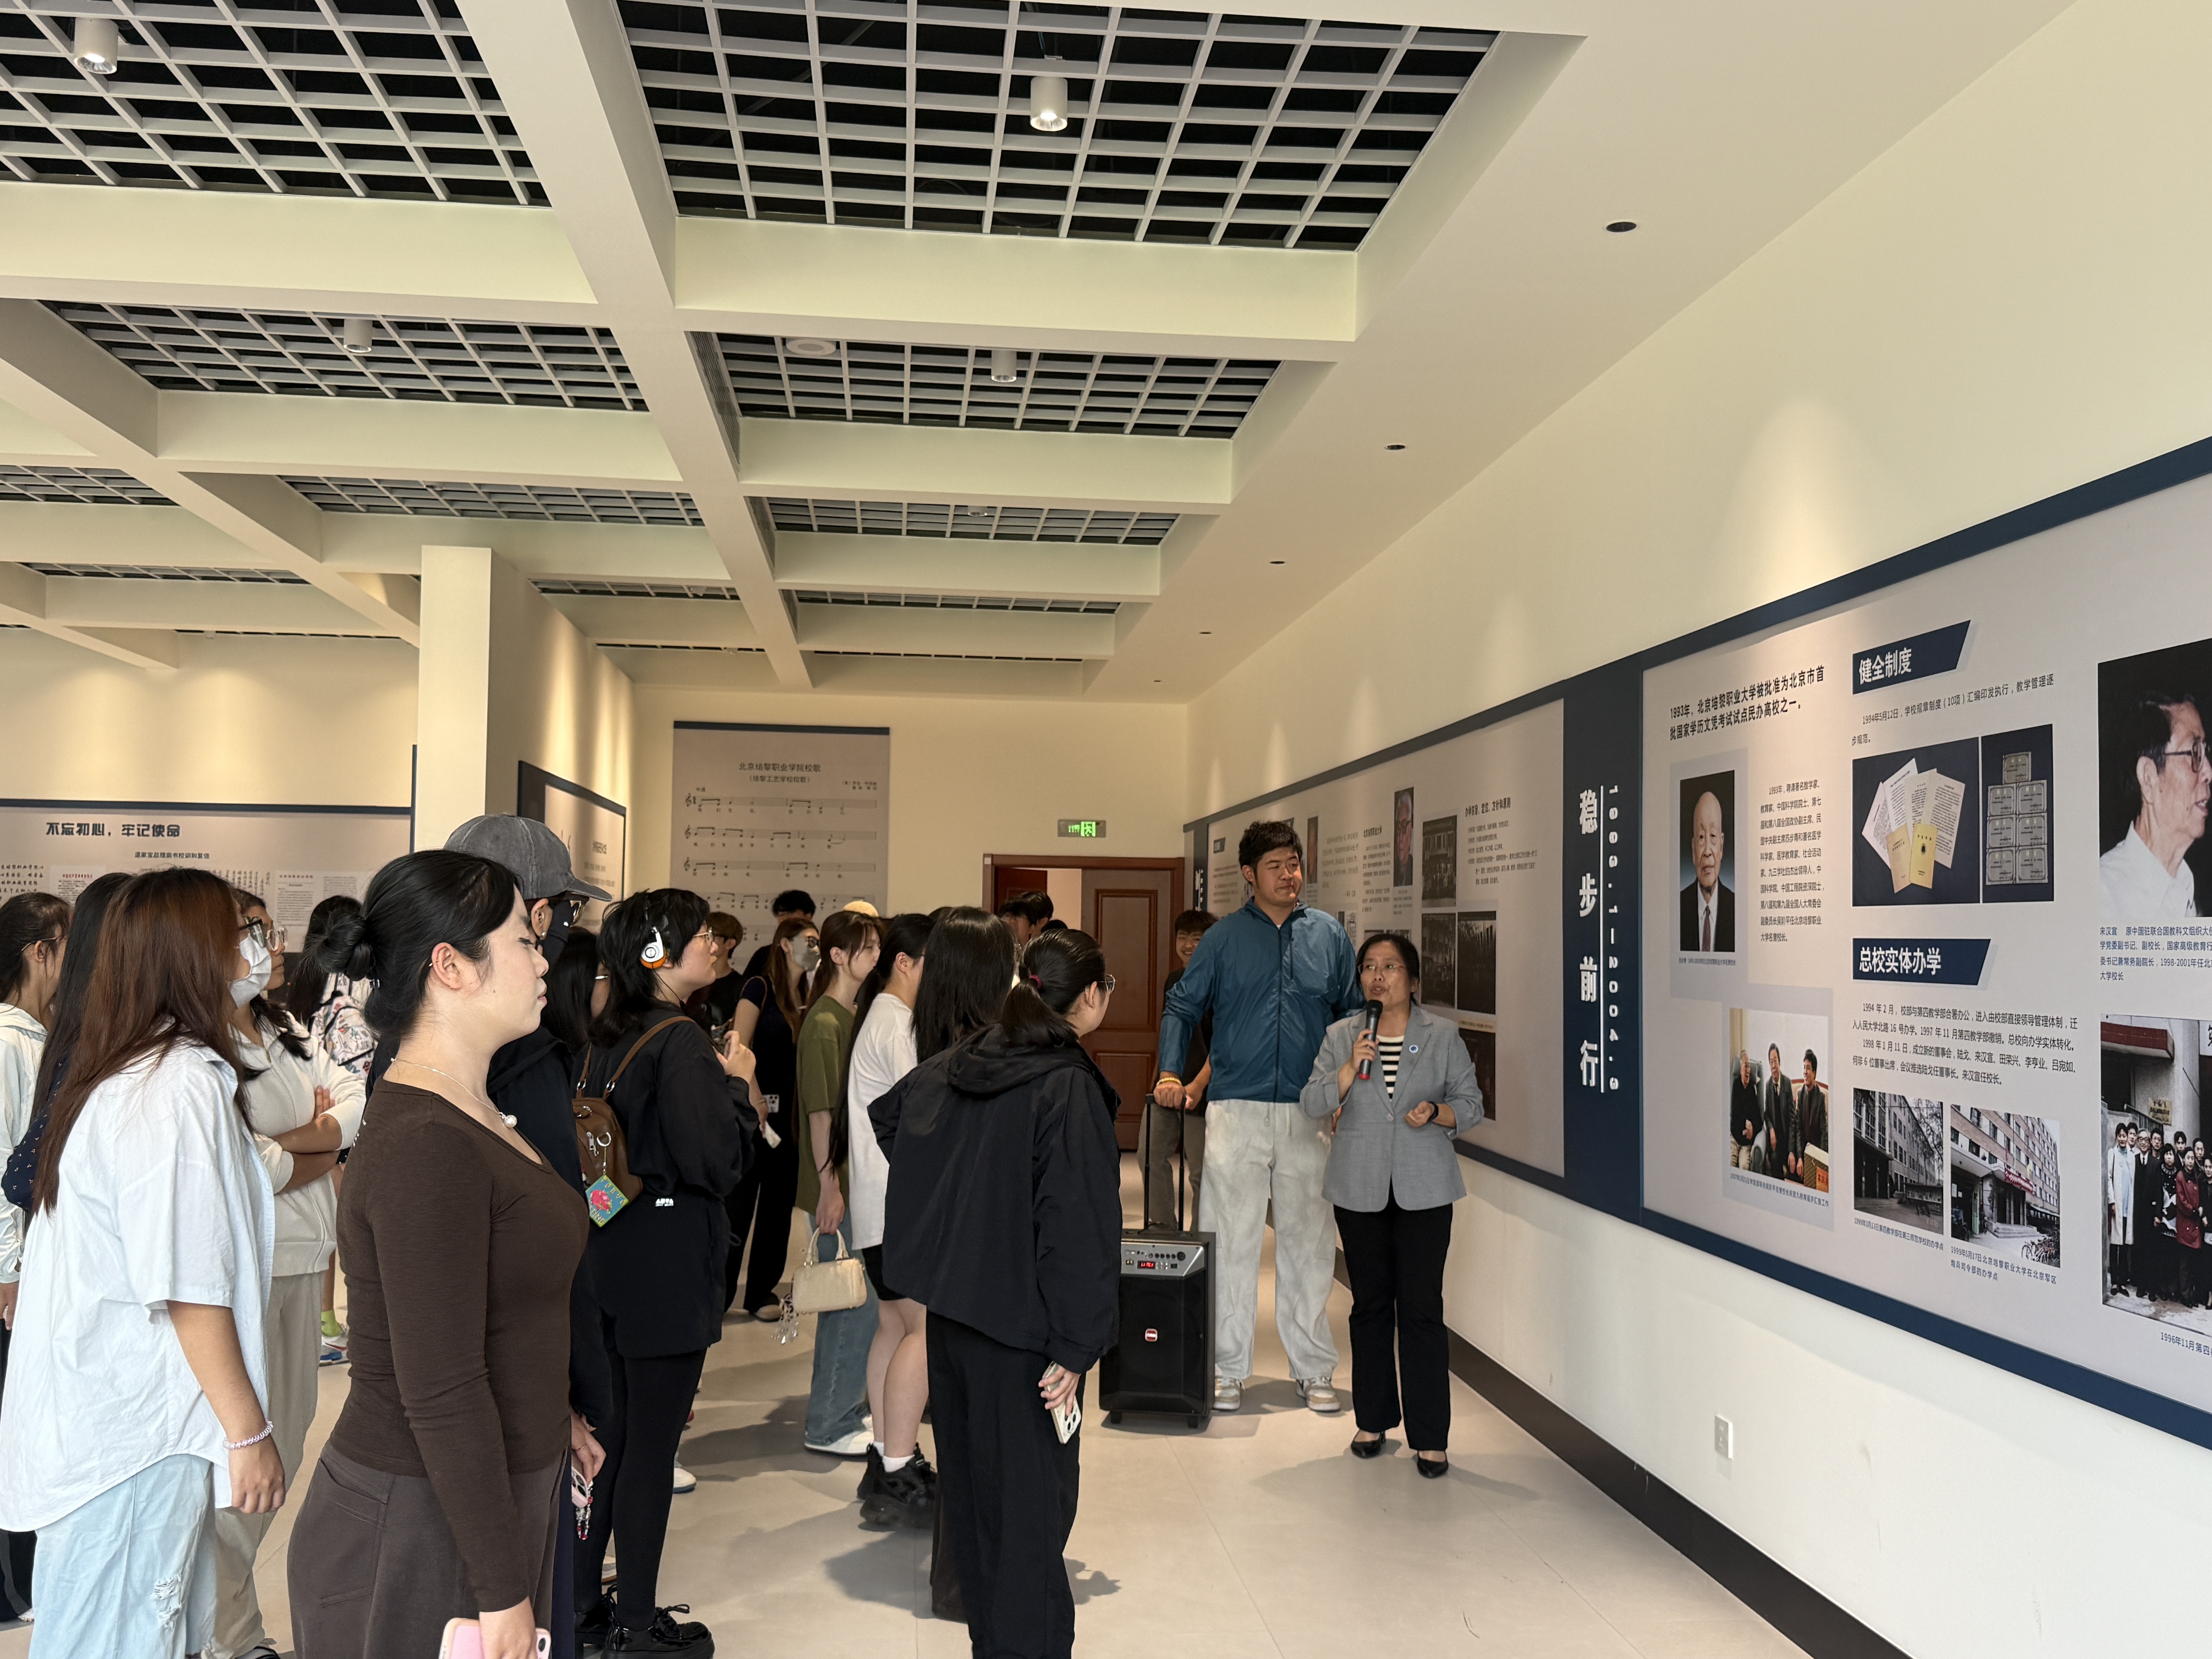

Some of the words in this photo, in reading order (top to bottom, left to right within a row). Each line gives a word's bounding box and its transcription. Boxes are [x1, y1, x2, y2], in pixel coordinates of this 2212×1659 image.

[1858, 647, 1912, 685] 健全制度
[1670, 665, 1824, 719] 1993年，北京培黎职业大学被批准为北京市首
[1670, 697, 1801, 740] 批国家学历文凭考试试点民办高校之一。
[739, 763, 821, 772] 北京培黎职业学院校歌
[46, 823, 180, 837] 不忘初心，牢记使命
[1579, 789, 1598, 1087] 稳步前行
[1859, 946, 1941, 975] 总校实体办学
[2100, 956, 2212, 968] 委书记兼常务副院长，1998-2001年任北
[2100, 971, 2124, 981] 大学校长
[2161, 1332, 2212, 1357] 1996年11月第四
